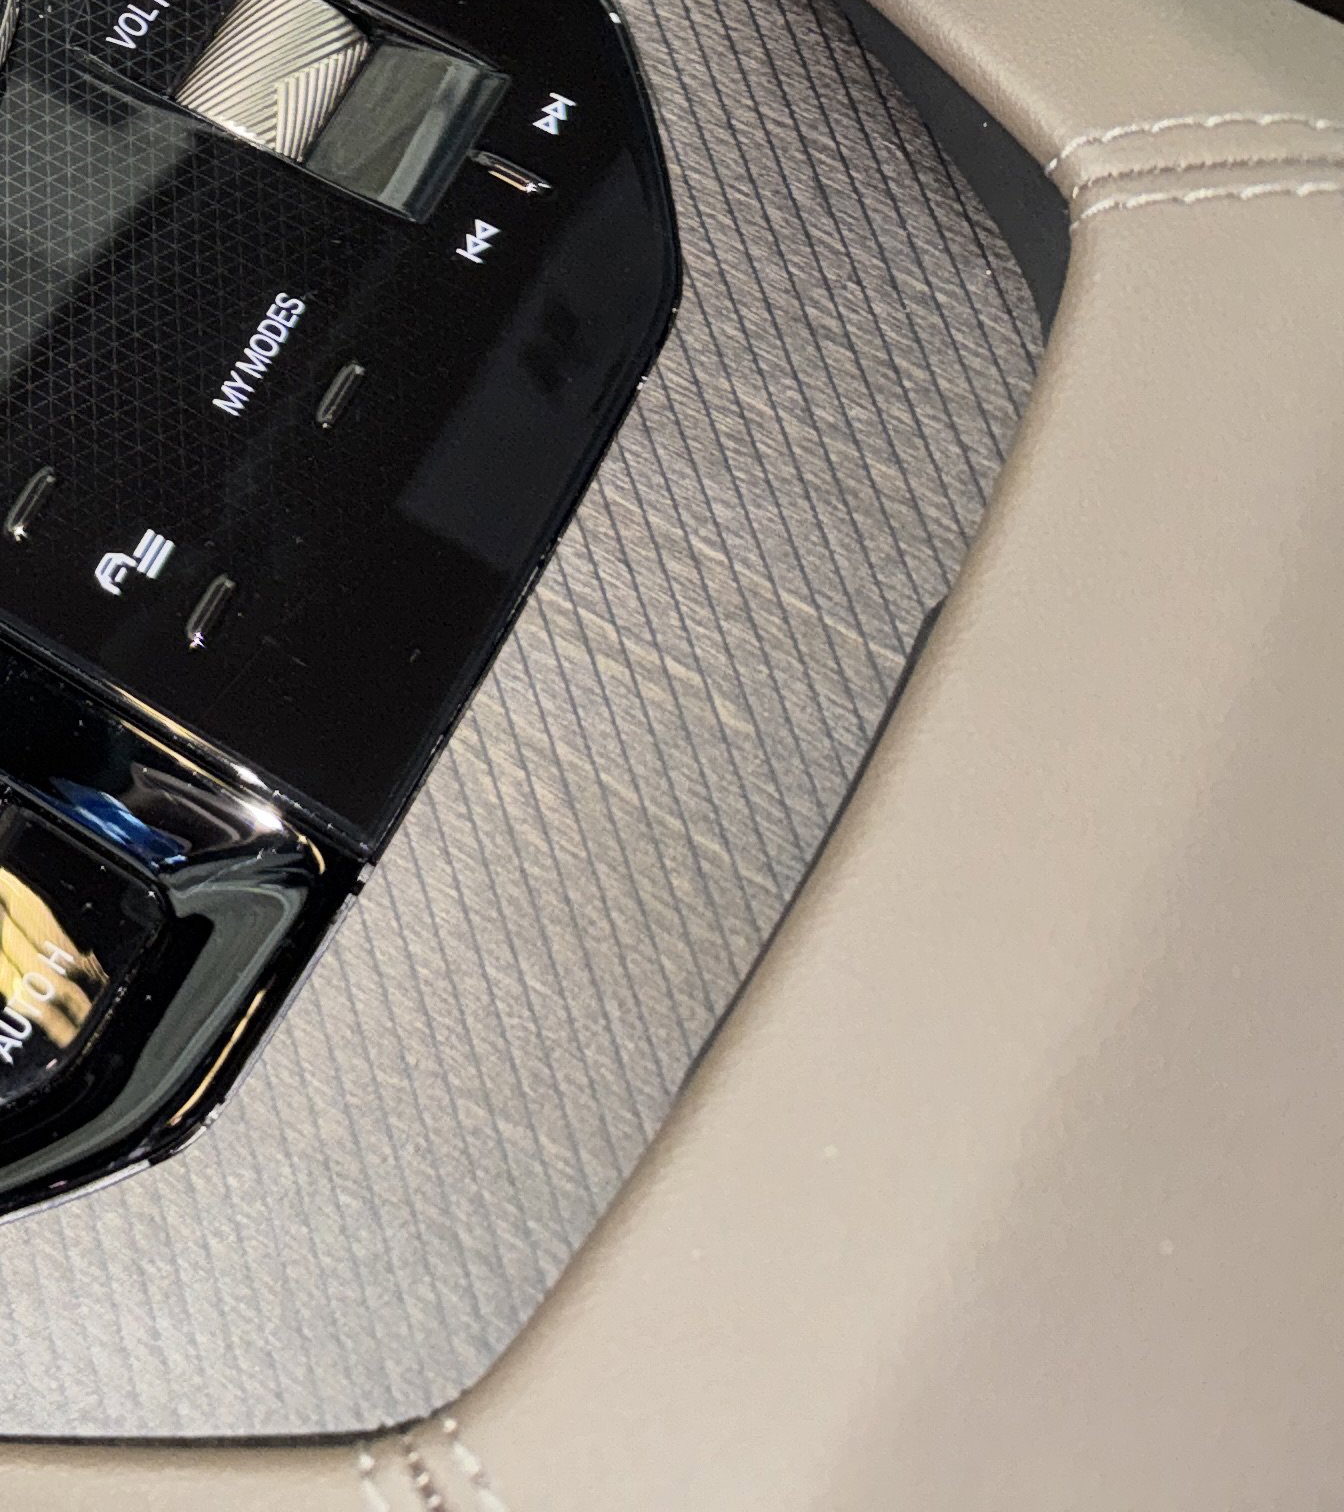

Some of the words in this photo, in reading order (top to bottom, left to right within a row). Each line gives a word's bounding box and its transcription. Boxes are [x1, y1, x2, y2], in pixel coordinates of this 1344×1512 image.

[106, 5, 160, 51] VOL
[212, 368, 257, 416] MY
[235, 292, 306, 380] MODES
[37, 940, 75, 976] H
